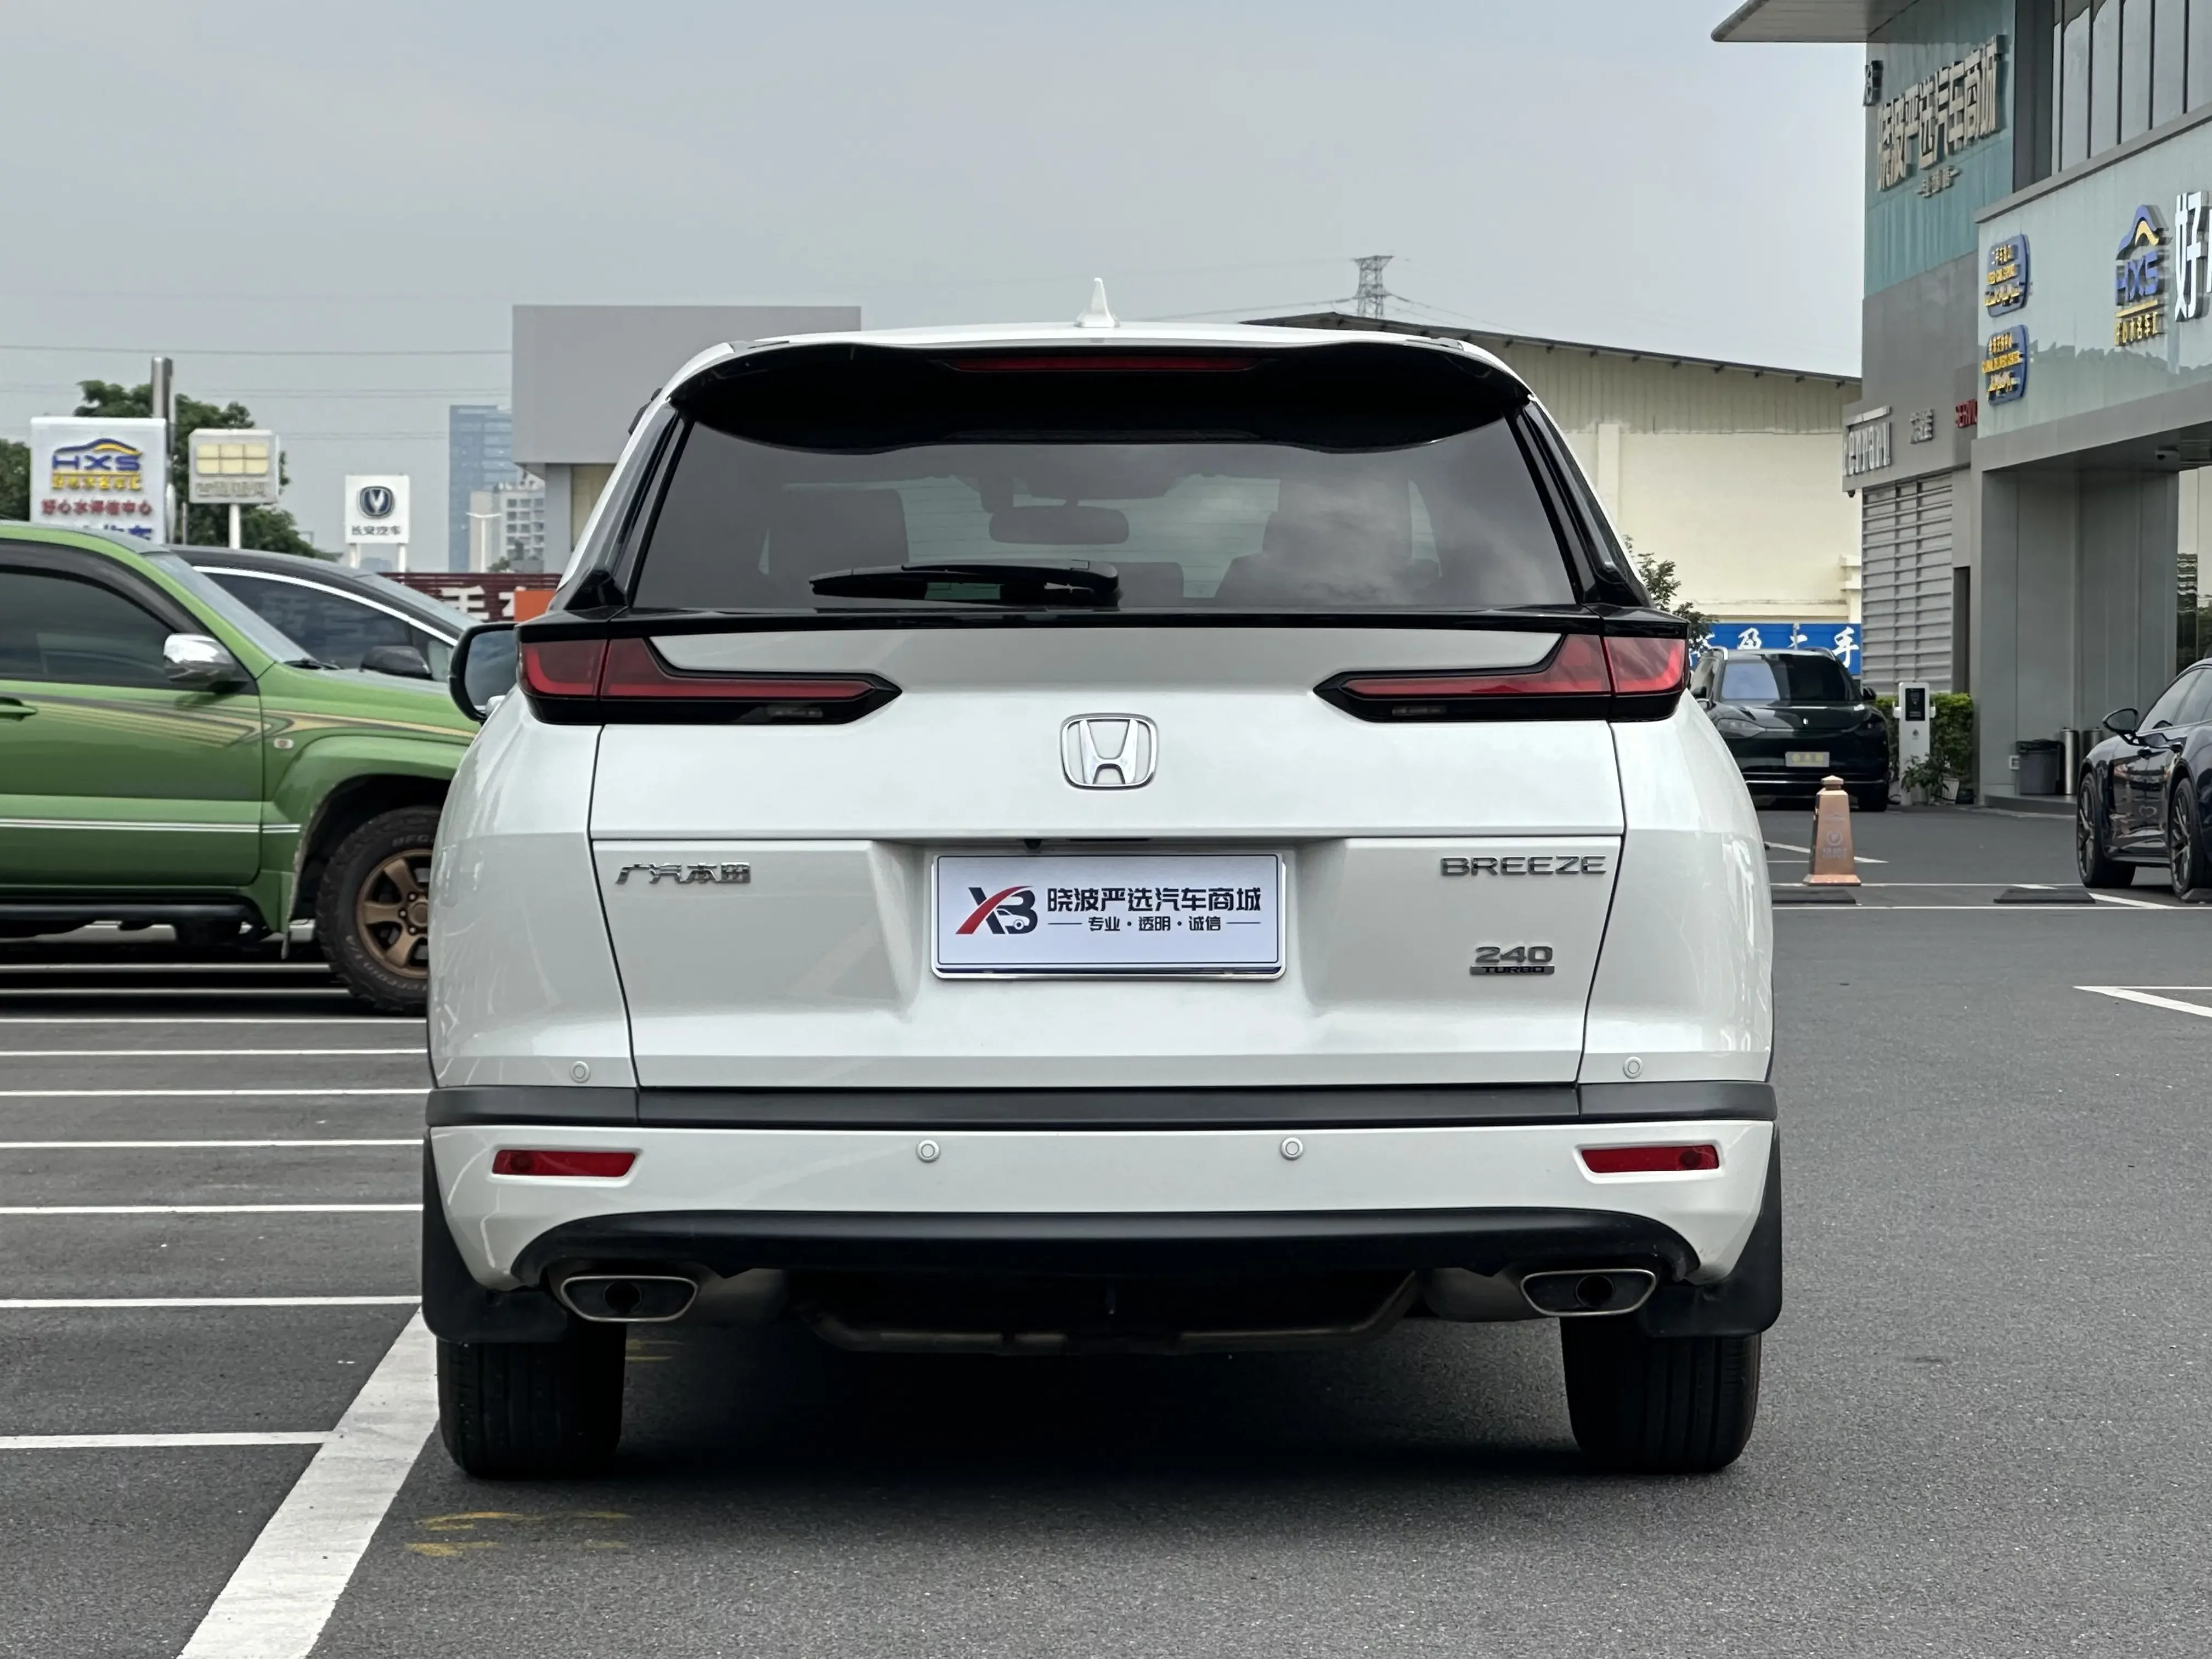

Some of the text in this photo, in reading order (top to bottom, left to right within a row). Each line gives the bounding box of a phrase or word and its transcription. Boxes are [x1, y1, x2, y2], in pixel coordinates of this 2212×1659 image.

[2175, 191, 2212, 320] 好
[2115, 250, 2158, 306] HXS
[52, 454, 140, 471] HXS
[615, 862, 751, 884] 广汽本田
[1441, 855, 1606, 876] BREEZE
[1047, 887, 1261, 912] 晓波严选汽车商城
[1475, 945, 1553, 963] 240
